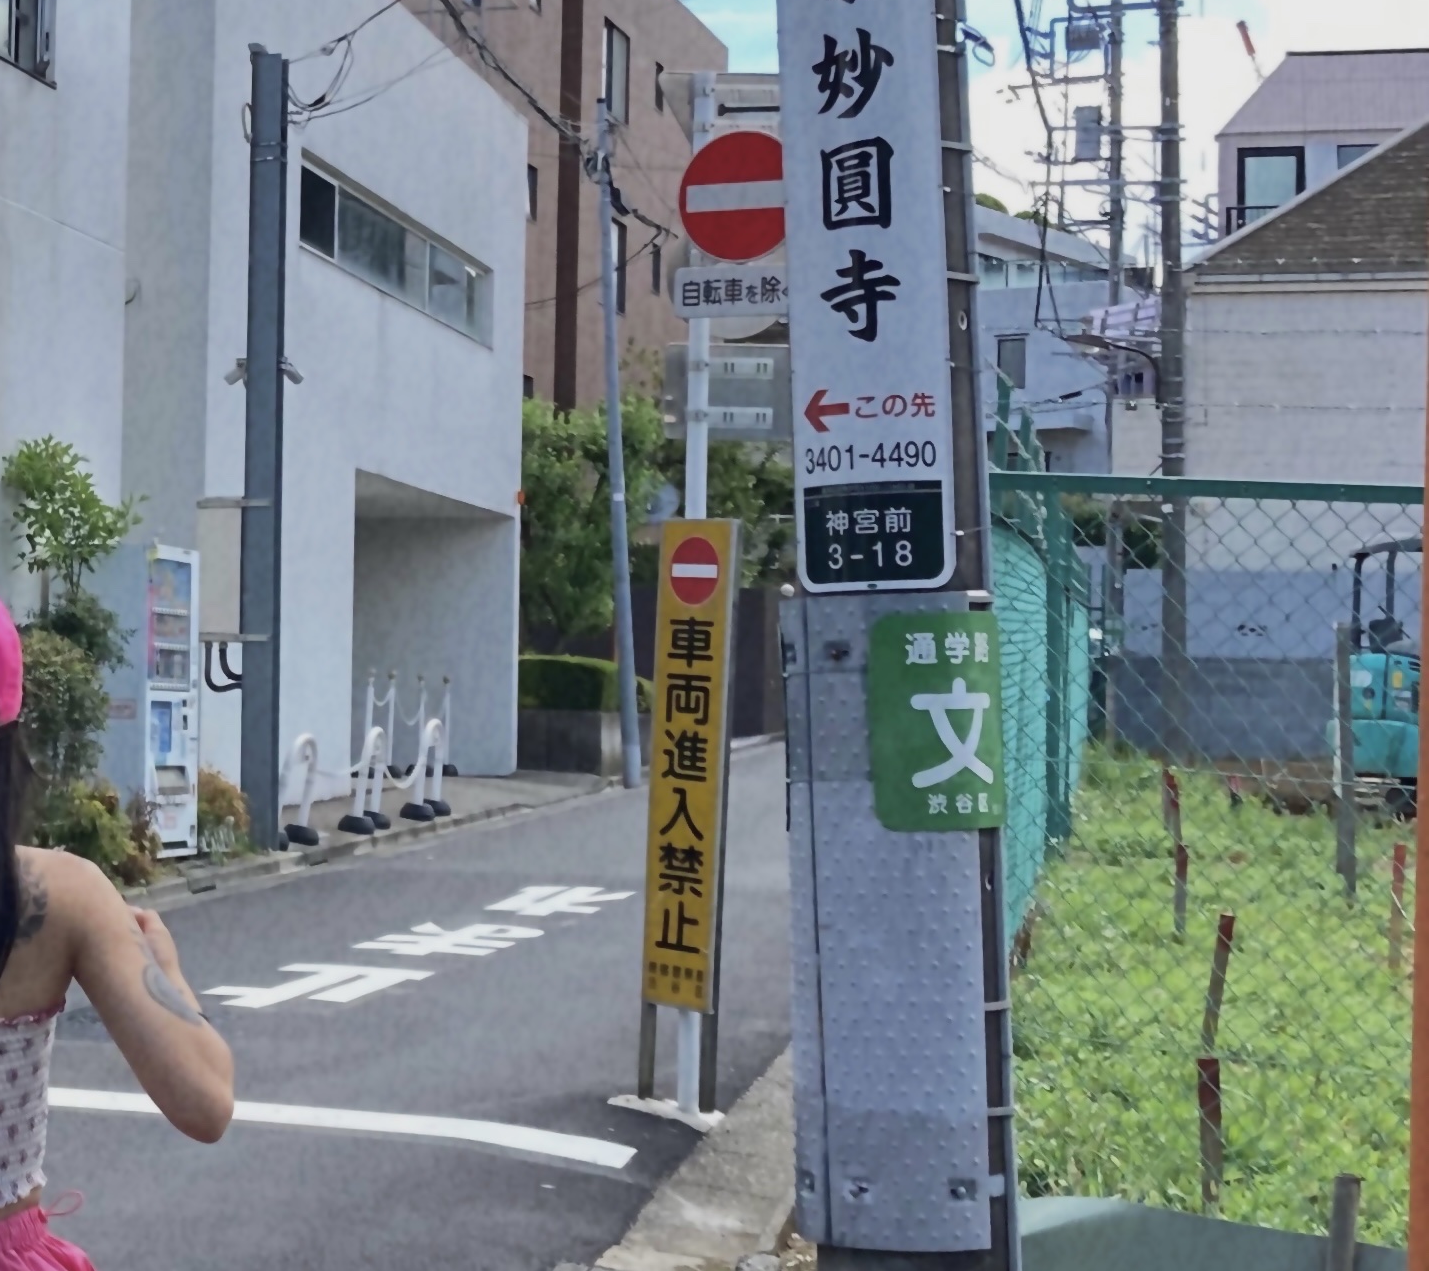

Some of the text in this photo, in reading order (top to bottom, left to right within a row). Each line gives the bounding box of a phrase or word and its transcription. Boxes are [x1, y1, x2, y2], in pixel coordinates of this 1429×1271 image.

[812, 28, 901, 343] 妙圓寺
[854, 392, 936, 419] この先
[805, 440, 937, 475] 3401-4490
[825, 506, 912, 536] 神宮前
[828, 540, 913, 570] 3-18
[655, 616, 714, 955] 車両進入禁止
[928, 792, 989, 815] 渋谷区
[201, 886, 637, 1009] 止まれ
